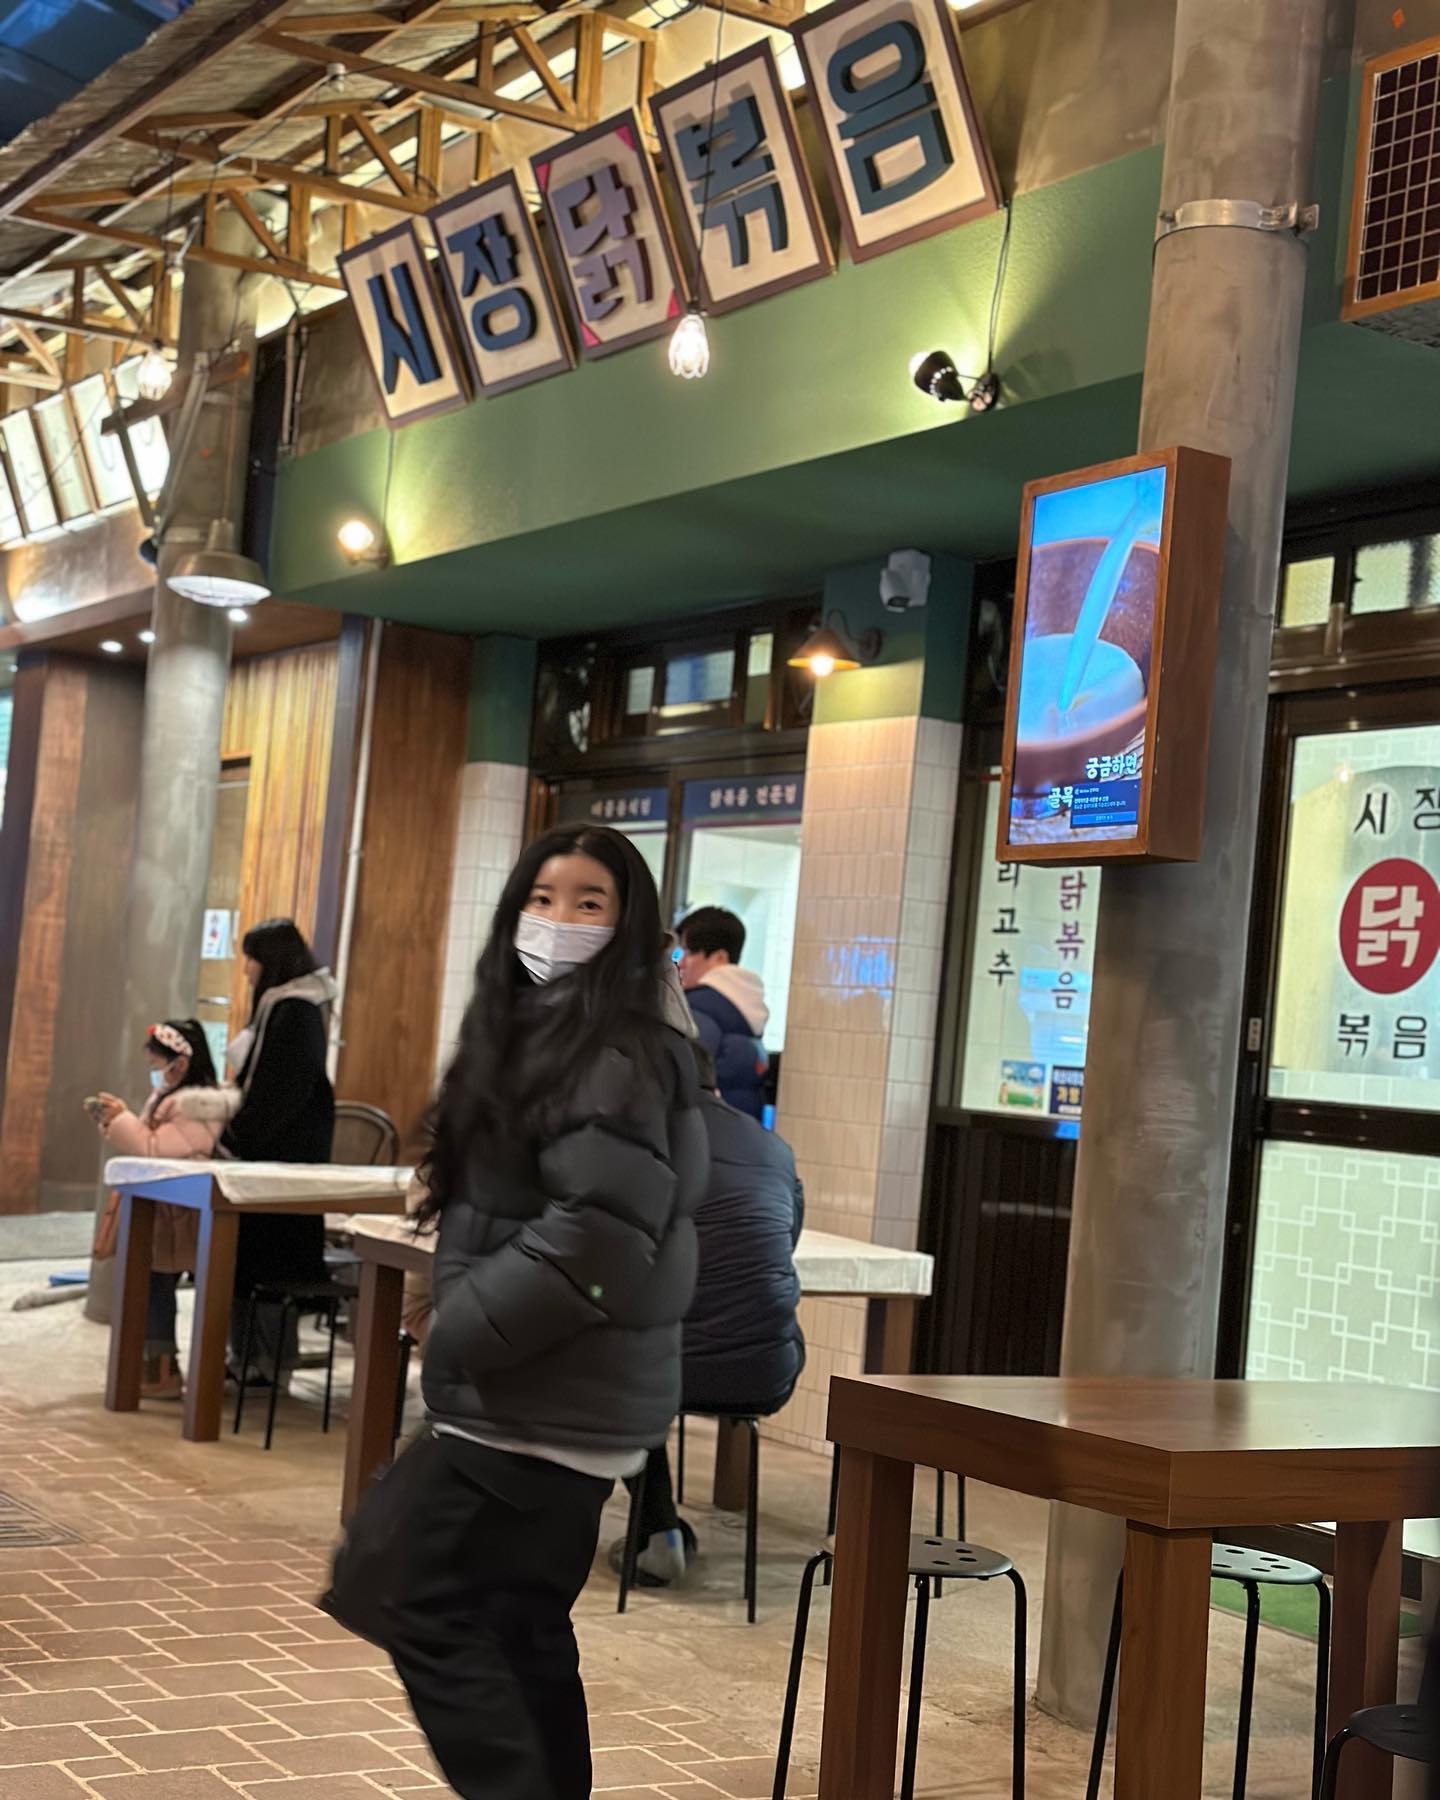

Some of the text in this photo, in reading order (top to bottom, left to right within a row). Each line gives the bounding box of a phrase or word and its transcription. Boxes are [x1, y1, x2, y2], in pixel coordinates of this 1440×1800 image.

[1085, 753, 1138, 779] 궁금하면
[1048, 786, 1073, 809] 골목
[1052, 871, 1088, 1009] 닭볶음
[1355, 886, 1425, 967] 닭
[1337, 1013, 1428, 1060] 볶음
